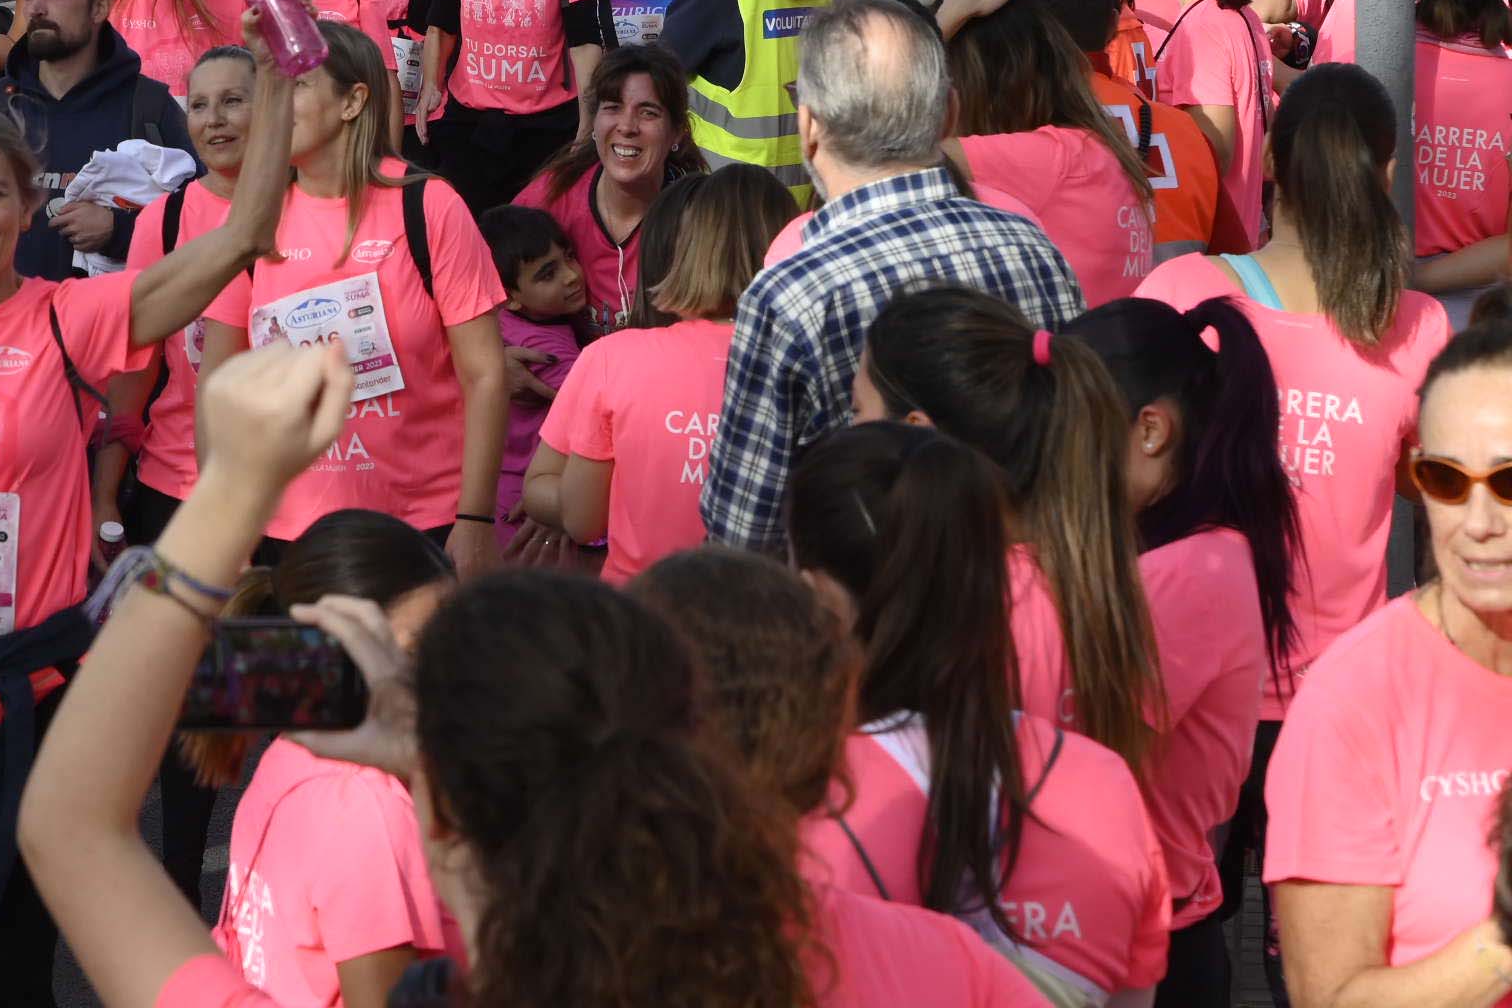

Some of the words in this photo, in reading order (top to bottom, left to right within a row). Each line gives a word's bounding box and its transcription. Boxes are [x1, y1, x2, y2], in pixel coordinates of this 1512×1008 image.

[465, 37, 478, 53] TU
[484, 43, 547, 58] DORSAL
[466, 53, 548, 83] SUMA
[1415, 123, 1505, 152] ARRERA
[1418, 145, 1448, 167] DE
[1455, 148, 1483, 170] LA
[1278, 388, 1364, 425] RERA
[1297, 419, 1333, 448] LA
